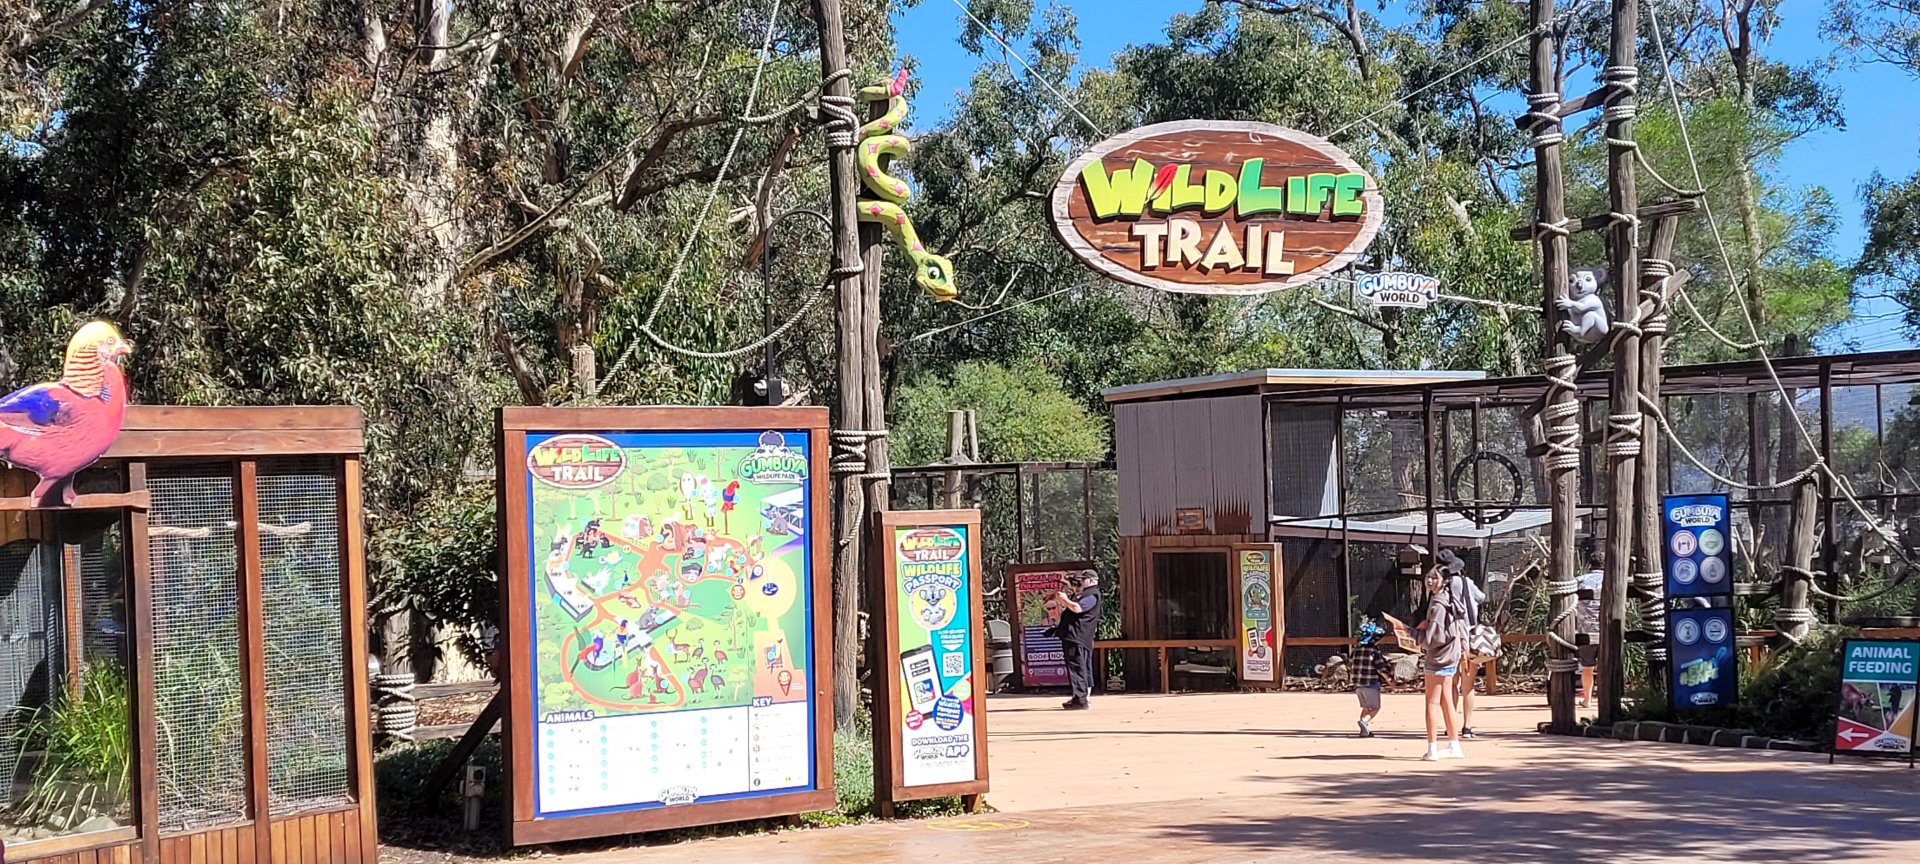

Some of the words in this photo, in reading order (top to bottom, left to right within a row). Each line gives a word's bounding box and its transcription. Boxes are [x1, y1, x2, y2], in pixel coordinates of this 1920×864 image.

[1081, 156, 1365, 218] WILDLIFE
[1131, 218, 1296, 276] TRAIL
[1358, 272, 1437, 300] GUMBUYA
[1380, 292, 1420, 303] WORLD
[533, 443, 621, 467] WILDLIFE
[551, 465, 604, 482] TRAIL
[740, 456, 807, 478] GUMBUYA
[1671, 505, 1722, 521] GUMBUYA
[1685, 516, 1710, 524] WORLD
[914, 549, 950, 561] TRAIL
[903, 562, 961, 578] WILDLIFE
[904, 573, 961, 593] PASSPORT
[1027, 652, 1049, 661] BOOK
[1851, 646, 1912, 659] ANIMAL
[1848, 661, 1912, 674] FEEDING
[752, 697, 773, 707] KEY
[546, 710, 594, 724] ANIMALS
[911, 735, 954, 746] DOWNLOAD
[954, 734, 970, 743] THE
[945, 744, 970, 758] APP
